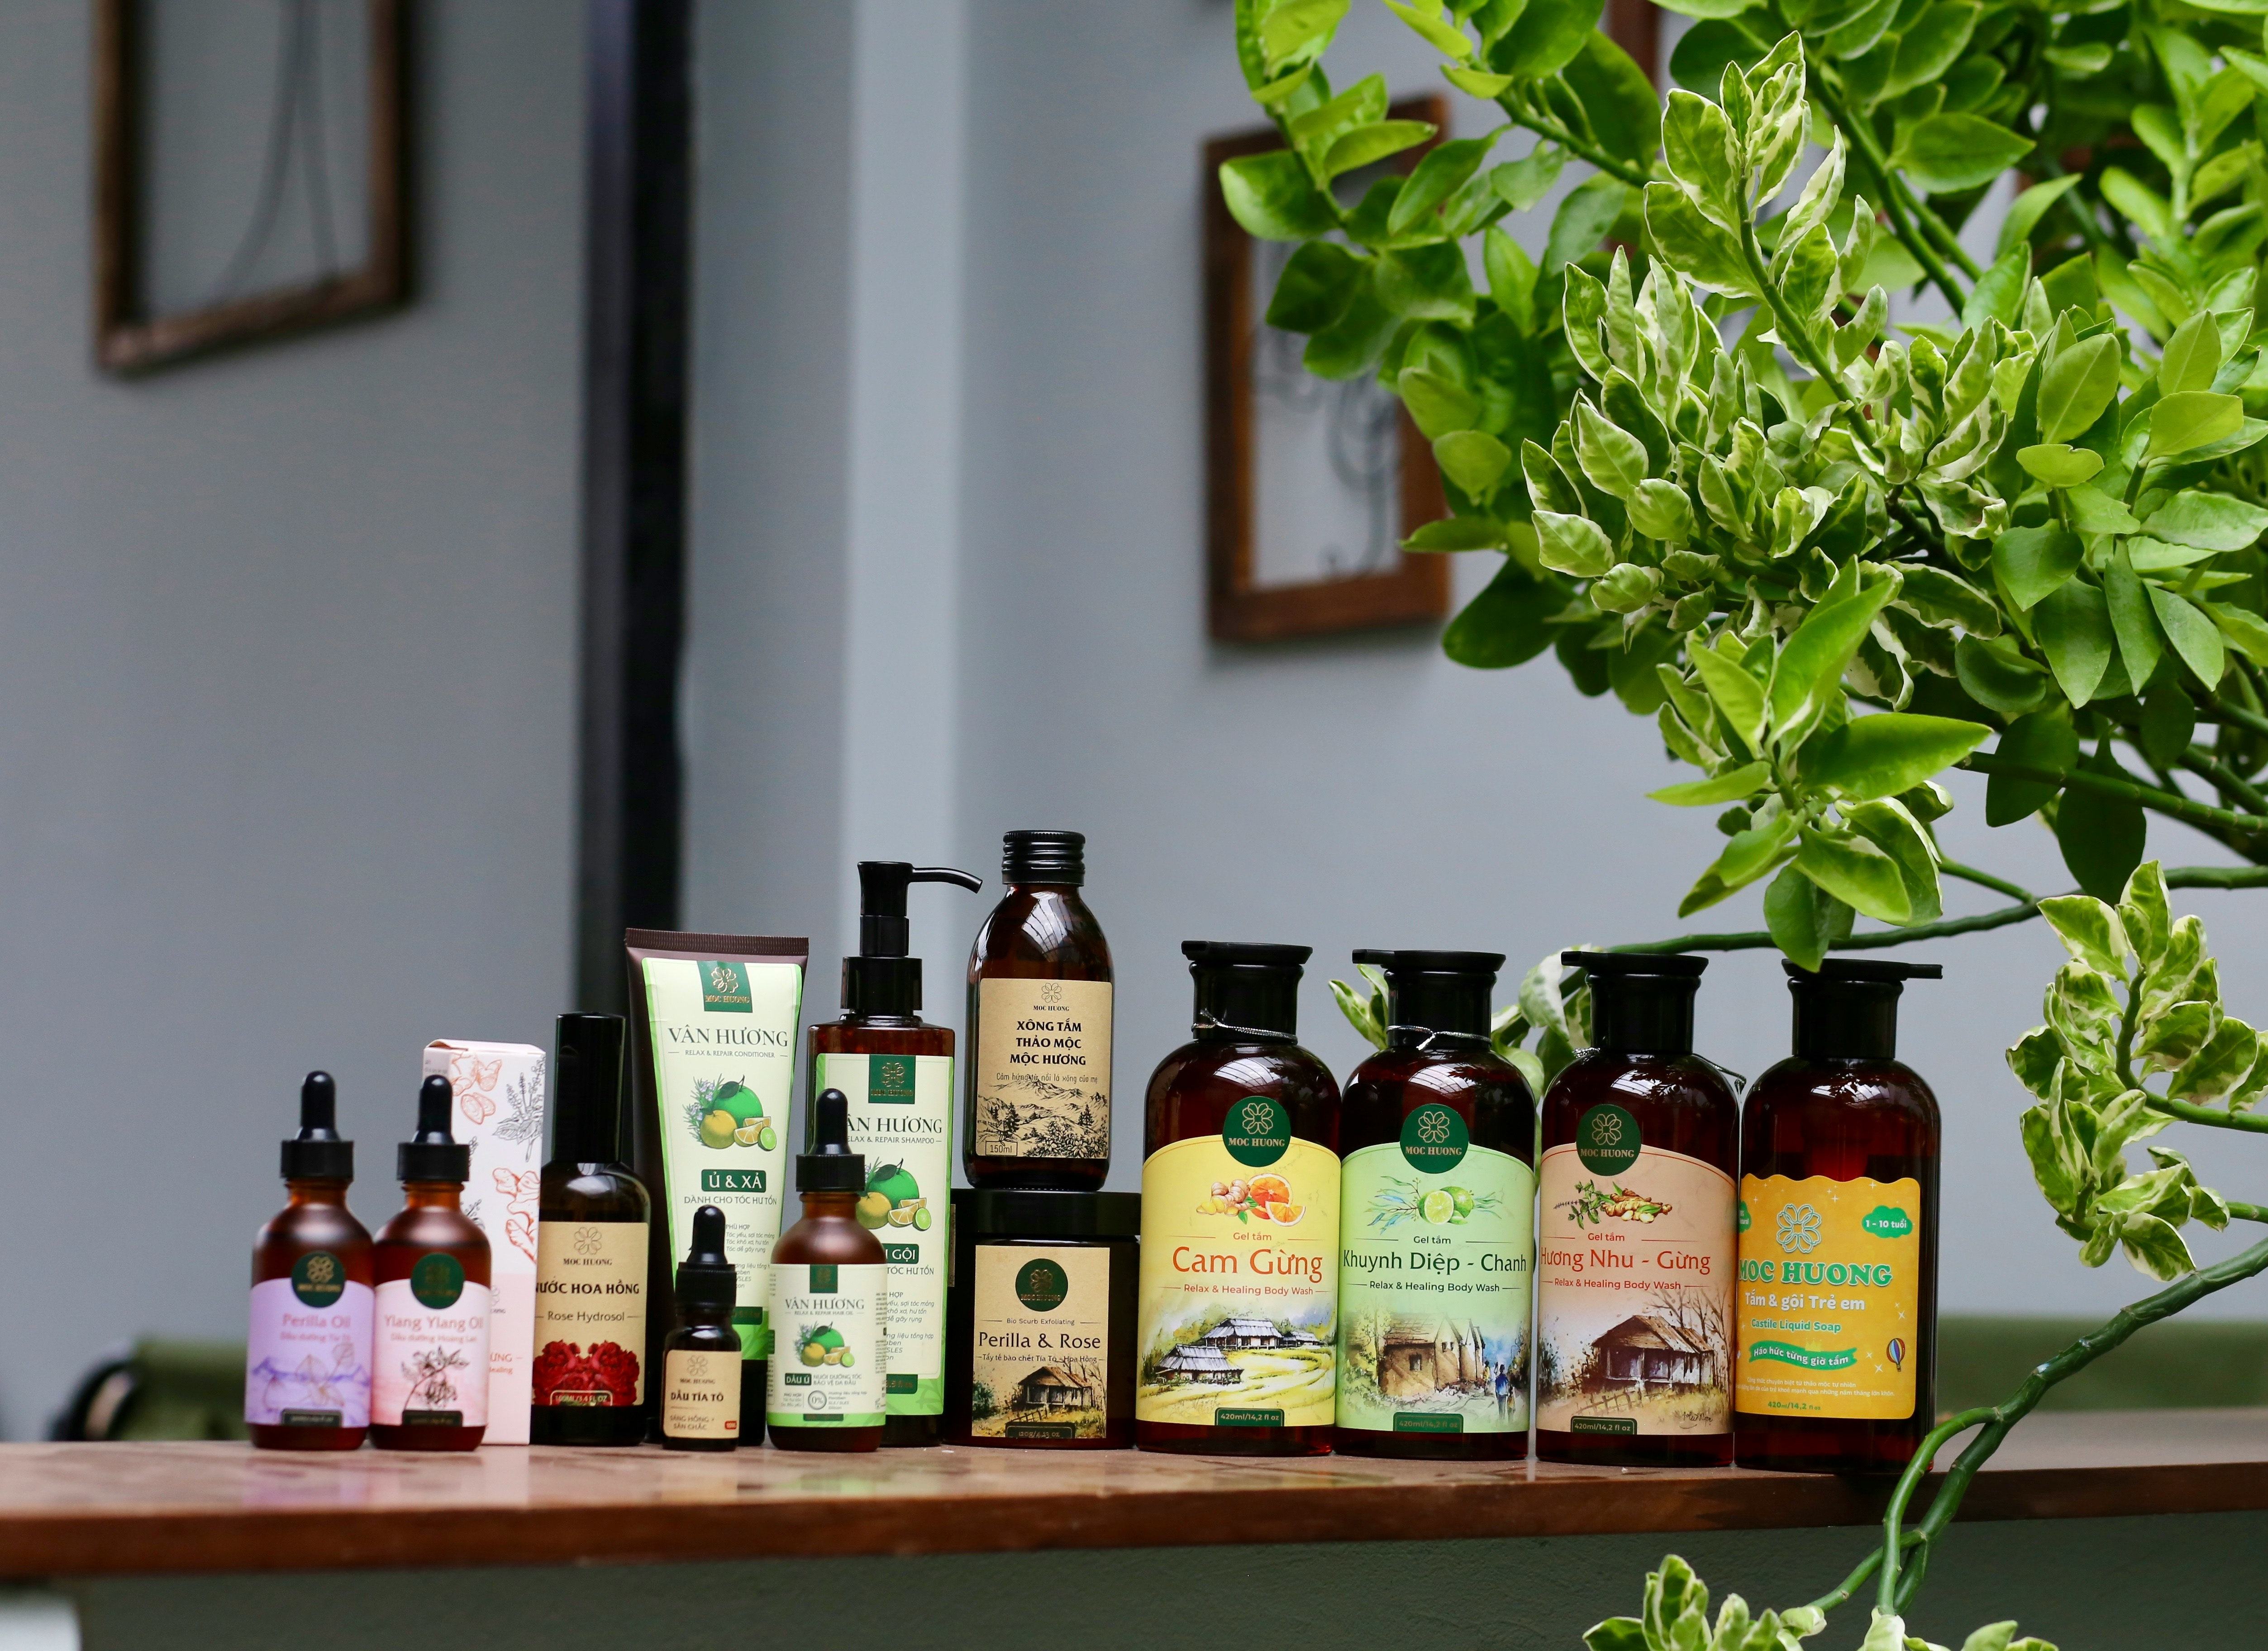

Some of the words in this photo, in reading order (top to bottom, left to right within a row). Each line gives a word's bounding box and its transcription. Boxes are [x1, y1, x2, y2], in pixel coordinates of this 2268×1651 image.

[1016, 1019, 1054, 1031] XÔNG
[1057, 1018, 1082, 1032] TẮM
[668, 1024, 713, 1044] VÂN
[716, 1027, 788, 1047] HƯƠNG
[1016, 1035, 1050, 1047] THẢO
[1053, 1037, 1082, 1050] MỘC
[1010, 1052, 1039, 1066] MỘC
[1043, 1054, 1086, 1065] HƯƠNG
[1063, 1074, 1077, 1083] xông
[877, 1116, 942, 1134] HƯƠNG
[1228, 1137, 1249, 1145] MOC
[1252, 1138, 1285, 1147] HUONG
[1428, 1147, 1462, 1155] HUONG
[1580, 1149, 1598, 1157] MOC
[1601, 1149, 1634, 1158] HUONG
[709, 1172, 720, 1188] Ủ
[725, 1175, 738, 1188] &
[742, 1173, 762, 1189] XẢ
[684, 1196, 711, 1204] DÀNH
[735, 1195, 751, 1204] TÓC
[1891, 1218, 1906, 1228] tuổi
[1253, 1231, 1272, 1241] tắm
[1432, 1236, 1451, 1244] tắm
[1605, 1232, 1625, 1241] tắm
[892, 1247, 915, 1262] GỘI
[1541, 1247, 1584, 1272] Hương
[1590, 1249, 1633, 1268] Nhu
[1657, 1251, 1711, 1275] Gừng
[1172, 1247, 1238, 1273] Cam
[1249, 1249, 1323, 1283] Gừng
[1344, 1249, 1401, 1272] Khuynh
[1410, 1252, 1460, 1275] Diệp
[1481, 1254, 1526, 1271] Chanh
[1739, 1259, 1774, 1282] MOC
[1781, 1261, 1893, 1286] HUONG
[571, 1284, 601, 1294] HOA
[606, 1279, 639, 1294] HỒNG
[1184, 1284, 1209, 1293] Relax
[1222, 1285, 1261, 1295] Healing
[1264, 1286, 1289, 1296] Body
[1292, 1287, 1313, 1295] Wash
[1406, 1282, 1444, 1292] Healing
[1448, 1284, 1473, 1293] Body
[1554, 1278, 1573, 1287] Relax
[1584, 1279, 1620, 1290] Healing
[1624, 1281, 1650, 1290] Body
[814, 1298, 864, 1309] HƯƠNG
[1745, 1289, 1765, 1306] Tắm
[1768, 1294, 1777, 1307] &
[1782, 1294, 1804, 1311] gội
[1809, 1295, 1836, 1309] Trẻ
[1840, 1300, 1865, 1310] em
[283, 1313, 327, 1327] Perilla
[332, 1315, 350, 1327] Oil
[385, 1315, 422, 1331] Ylang
[427, 1317, 465, 1332] Ylang
[469, 1317, 483, 1329] Oil
[548, 1312, 573, 1321] Rose
[577, 1312, 624, 1323] Hydrosol
[1752, 1319, 1777, 1328] Castile
[1780, 1320, 1811, 1332] Liquid
[1814, 1322, 1841, 1334] Soap
[979, 1332, 1031, 1347] Perilla
[1038, 1333, 1053, 1348] &
[1060, 1334, 1101, 1348] Rose
[1754, 1346, 1767, 1356] Háo
[1769, 1346, 1783, 1356] hức
[1786, 1351, 1808, 1365] từng
[1811, 1357, 1826, 1366] giờ
[1829, 1355, 1848, 1365] tắm
[1768, 1401, 1806, 1410] 420ml/14,2
